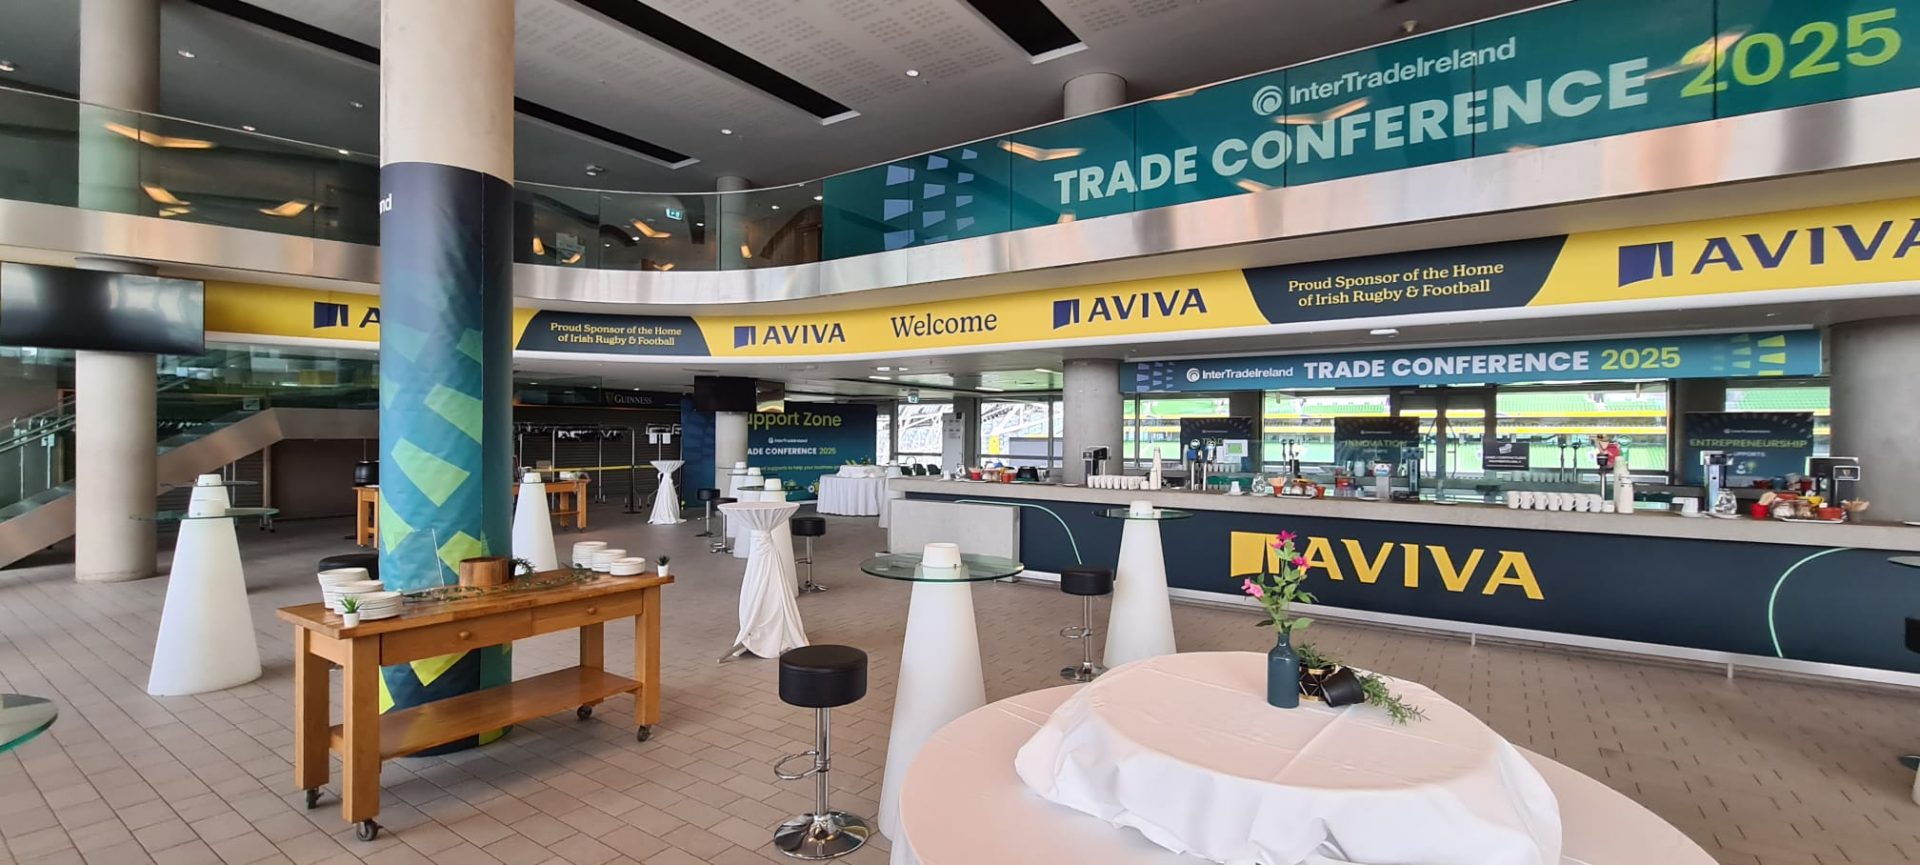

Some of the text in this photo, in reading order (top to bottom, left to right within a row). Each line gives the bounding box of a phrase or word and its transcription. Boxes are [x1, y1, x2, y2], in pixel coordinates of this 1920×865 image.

[1290, 37, 1516, 105] InterTradeIreland
[1053, 8, 1902, 205] TRADE CONFERENCE 2025
[1288, 263, 1505, 292] Proud Sponsor of the Home
[1087, 288, 1208, 323] AVIVA
[1298, 279, 1491, 307] of Irish Rugby & Football
[550, 322, 682, 336] Proud Sponsor of the Home
[762, 323, 847, 345] AVIVA
[890, 312, 998, 339] Welcome
[558, 333, 675, 346] of Irish Rugby & Football
[1202, 346, 1682, 380] InterTradeIreland TRADE CONFERENCE 2025
[747, 411, 842, 431] upport Zone
[747, 447, 837, 455] ADE CONFERENCE 2025
[1689, 439, 1808, 448] ENTREPRENEURSHIP
[1299, 536, 1545, 600] AVIVA
